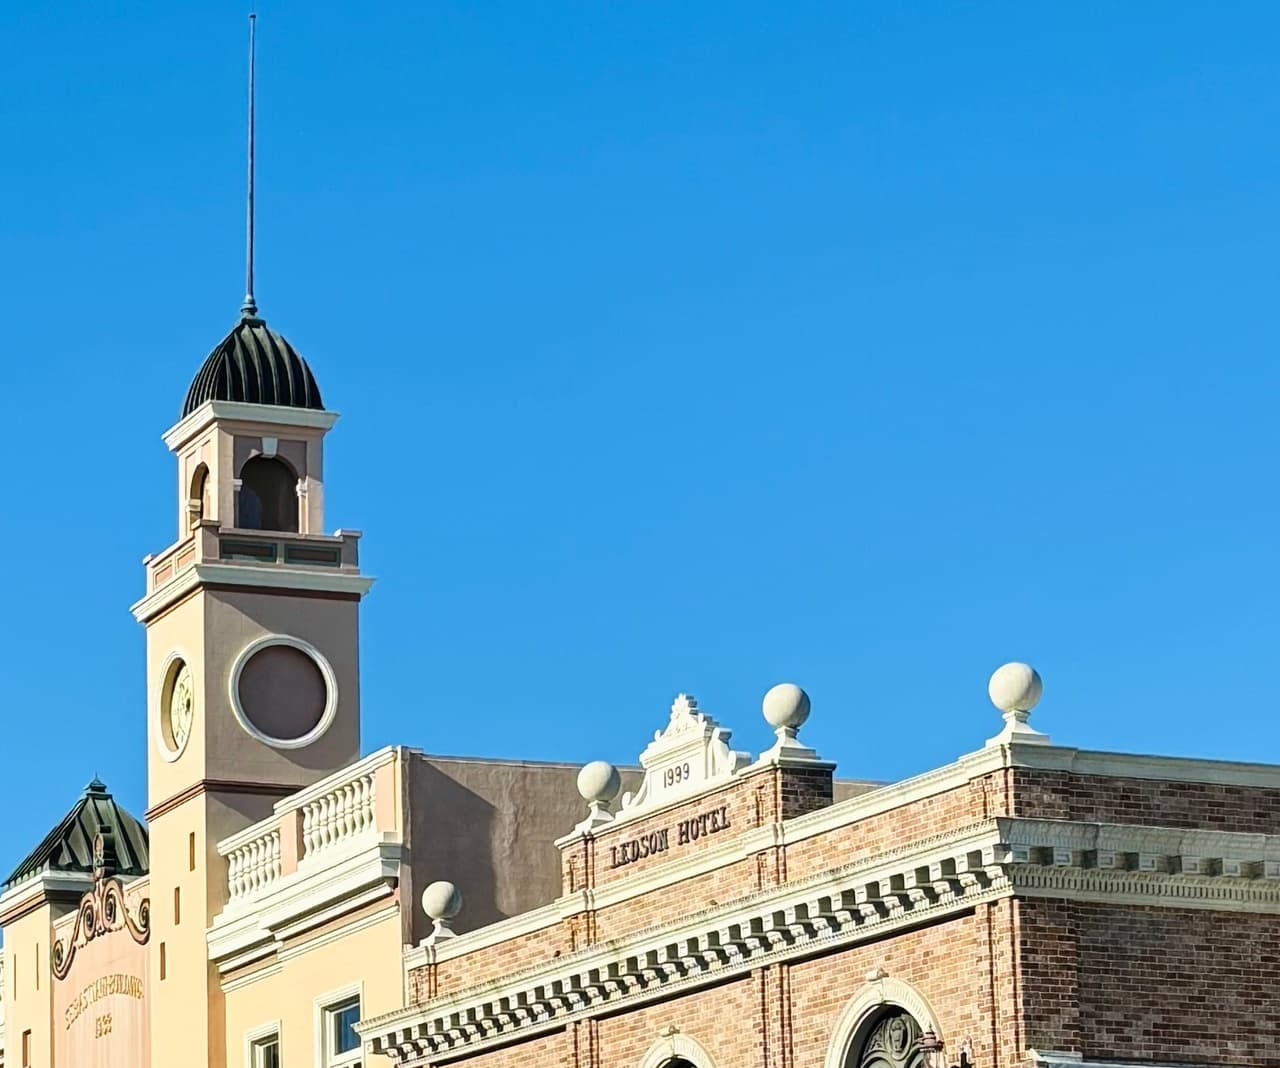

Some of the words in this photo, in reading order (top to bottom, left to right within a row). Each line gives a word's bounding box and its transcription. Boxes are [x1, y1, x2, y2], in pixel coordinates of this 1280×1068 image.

[663, 763, 690, 789] 1999
[610, 828, 669, 869] LEDSON
[678, 806, 731, 845] HOTEL
